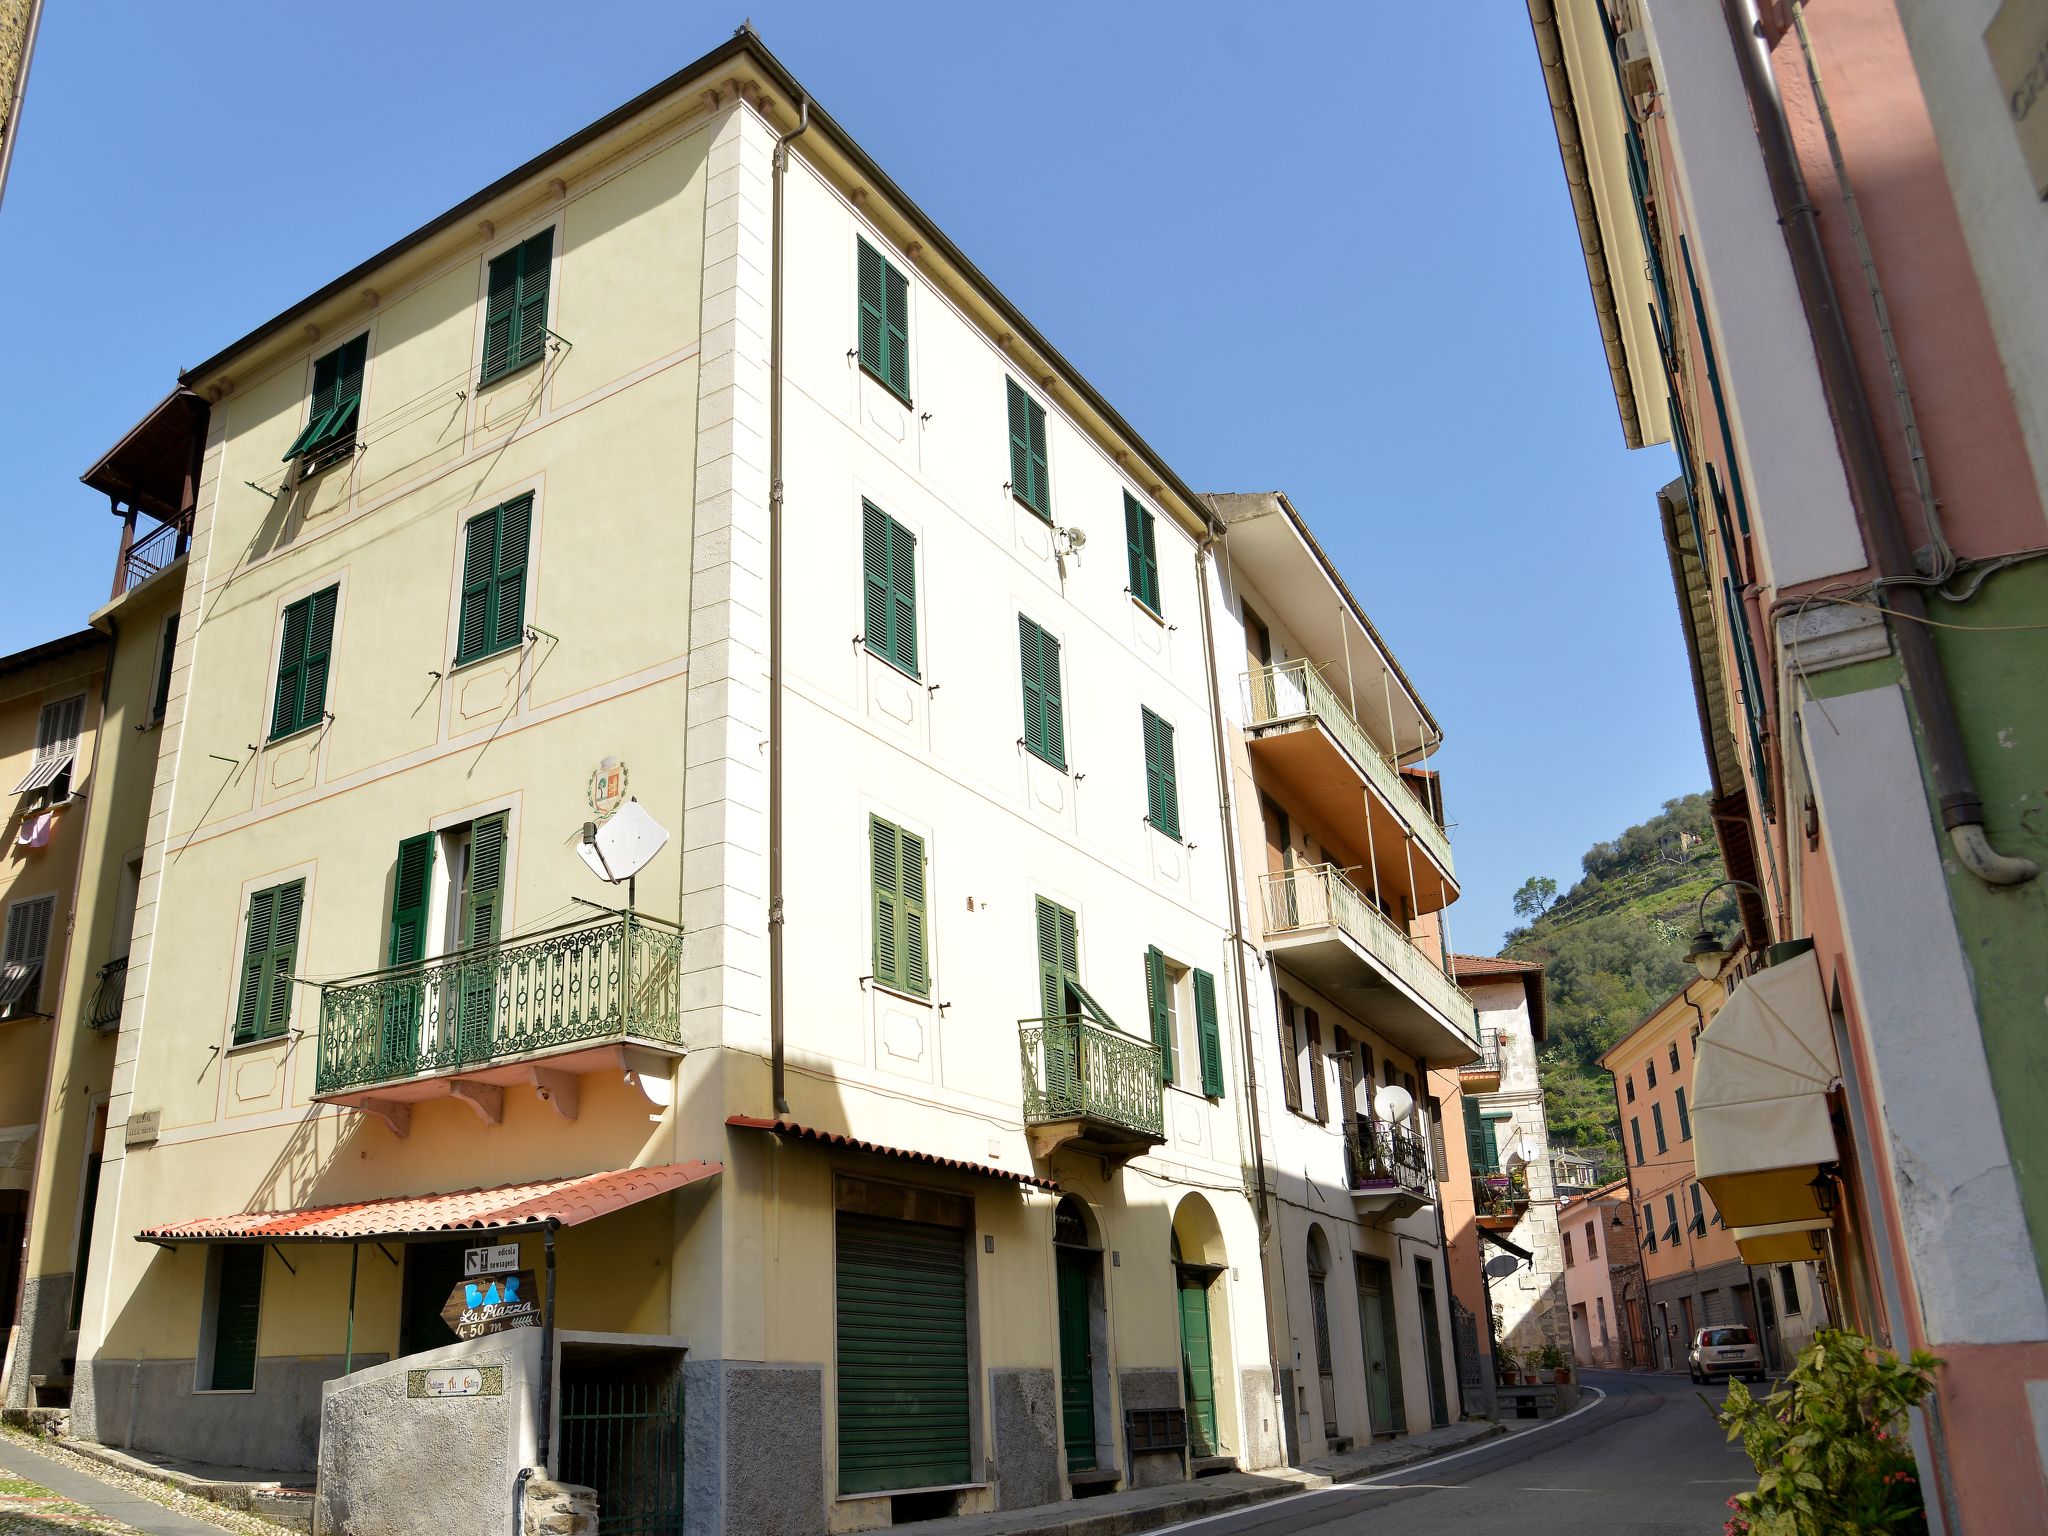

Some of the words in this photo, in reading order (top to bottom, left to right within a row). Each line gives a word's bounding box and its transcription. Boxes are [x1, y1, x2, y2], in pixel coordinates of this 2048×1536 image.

[498, 1247, 516, 1256] edicola
[489, 1260, 516, 1269] newsagent
[465, 1276, 520, 1309] BAR
[460, 1309, 479, 1323] La
[480, 1302, 532, 1321] Piazza
[470, 1323, 484, 1338] 50
[490, 1322, 503, 1332] m
